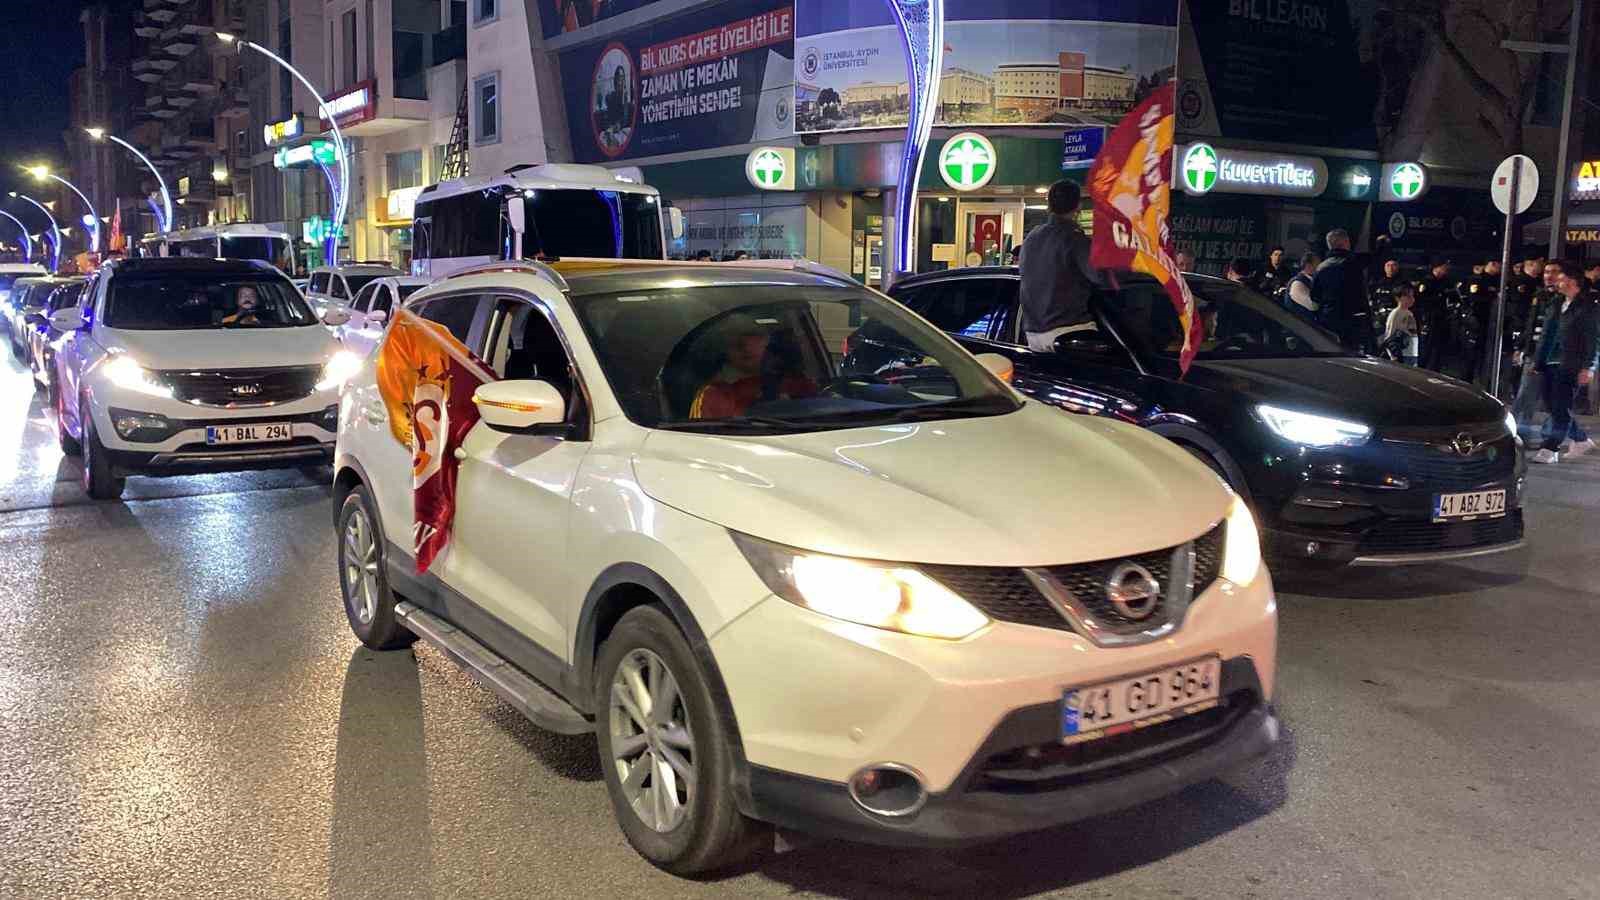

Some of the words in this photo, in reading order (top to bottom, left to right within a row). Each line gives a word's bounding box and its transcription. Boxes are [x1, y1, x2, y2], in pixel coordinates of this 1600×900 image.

[659, 44, 687, 67] KURS
[688, 35, 718, 59] CAFE
[720, 15, 767, 50] ÜYELİĞİ
[769, 13, 790, 38] İLE
[641, 70, 678, 98] ZAMAN
[679, 67, 695, 90] VE
[696, 56, 739, 86] MEKÂN
[641, 92, 698, 124] YÖNETİMİN
[699, 86, 741, 114] SENDE!
[215, 427, 229, 441] 41
[236, 428, 259, 441] BAL
[265, 426, 288, 439] 294
[1441, 496, 1454, 514] 41
[1460, 494, 1481, 513] ABZ
[1486, 492, 1504, 510] 972
[1082, 688, 1113, 720] 41
[1126, 676, 1162, 713] GD
